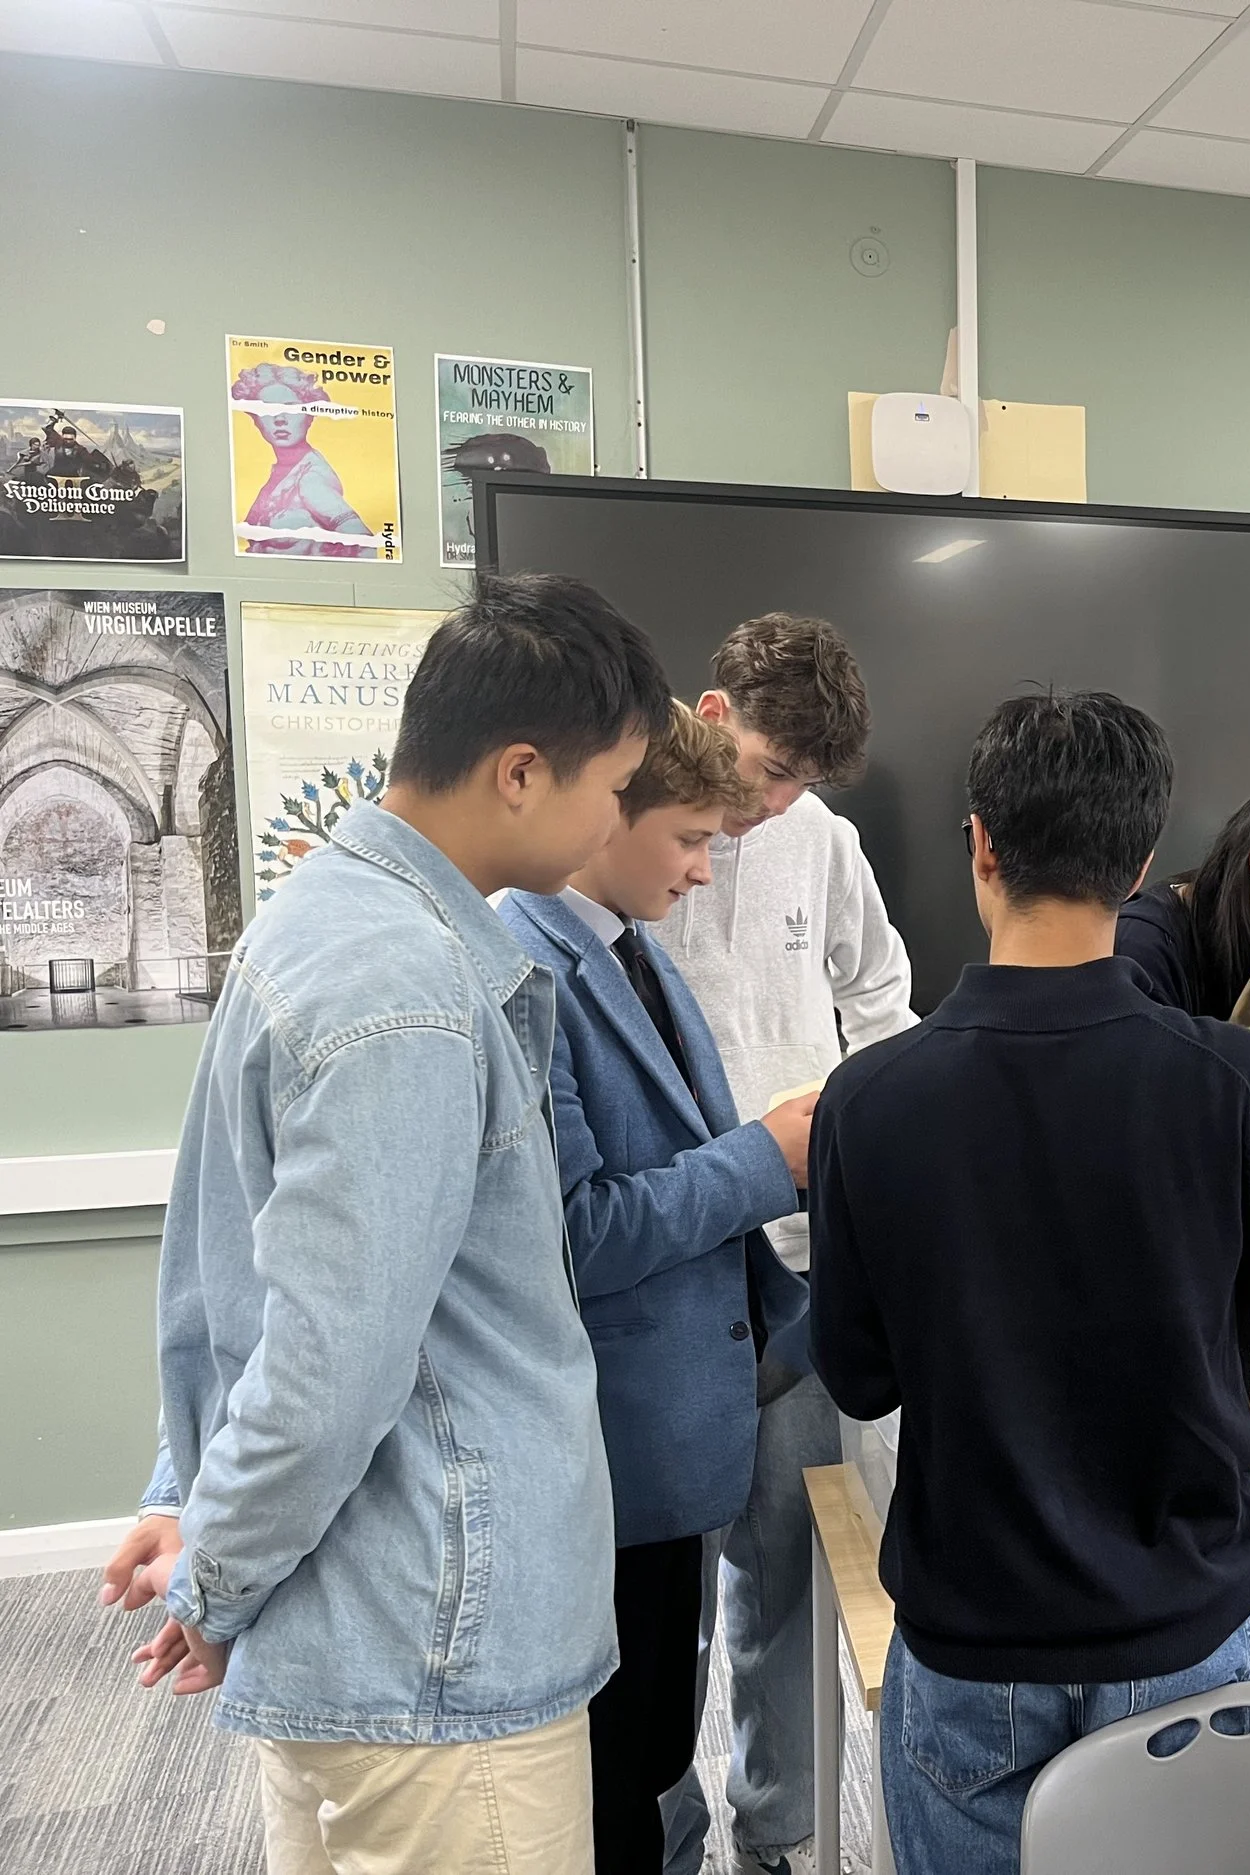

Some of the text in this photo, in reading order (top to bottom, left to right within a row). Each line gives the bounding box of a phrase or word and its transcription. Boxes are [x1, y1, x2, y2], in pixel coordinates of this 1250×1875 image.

[244, 340, 269, 348] Smith
[283, 347, 391, 369] Gender &
[321, 369, 391, 386] power
[453, 363, 576, 395] MONSTERS &
[471, 388, 554, 415] MAYHEM
[310, 405, 359, 416] disruptive
[361, 409, 395, 420] history
[443, 410, 587, 433] FEARING THE OTHER IN HISTORY
[3, 480, 136, 502] Kingdom Come
[22, 498, 116, 515] Deliverance
[382, 522, 396, 560] Hydra
[446, 541, 476, 555] Hydra
[83, 601, 157, 615] WIEN MUSEUM
[84, 614, 217, 637] VIRGILKAPELLE
[304, 640, 425, 659] MEETINGS
[266, 683, 400, 707] MANUS
[0, 878, 32, 898] EUM
[13, 922, 49, 935] MIDDLE
[50, 922, 76, 934] AGES
